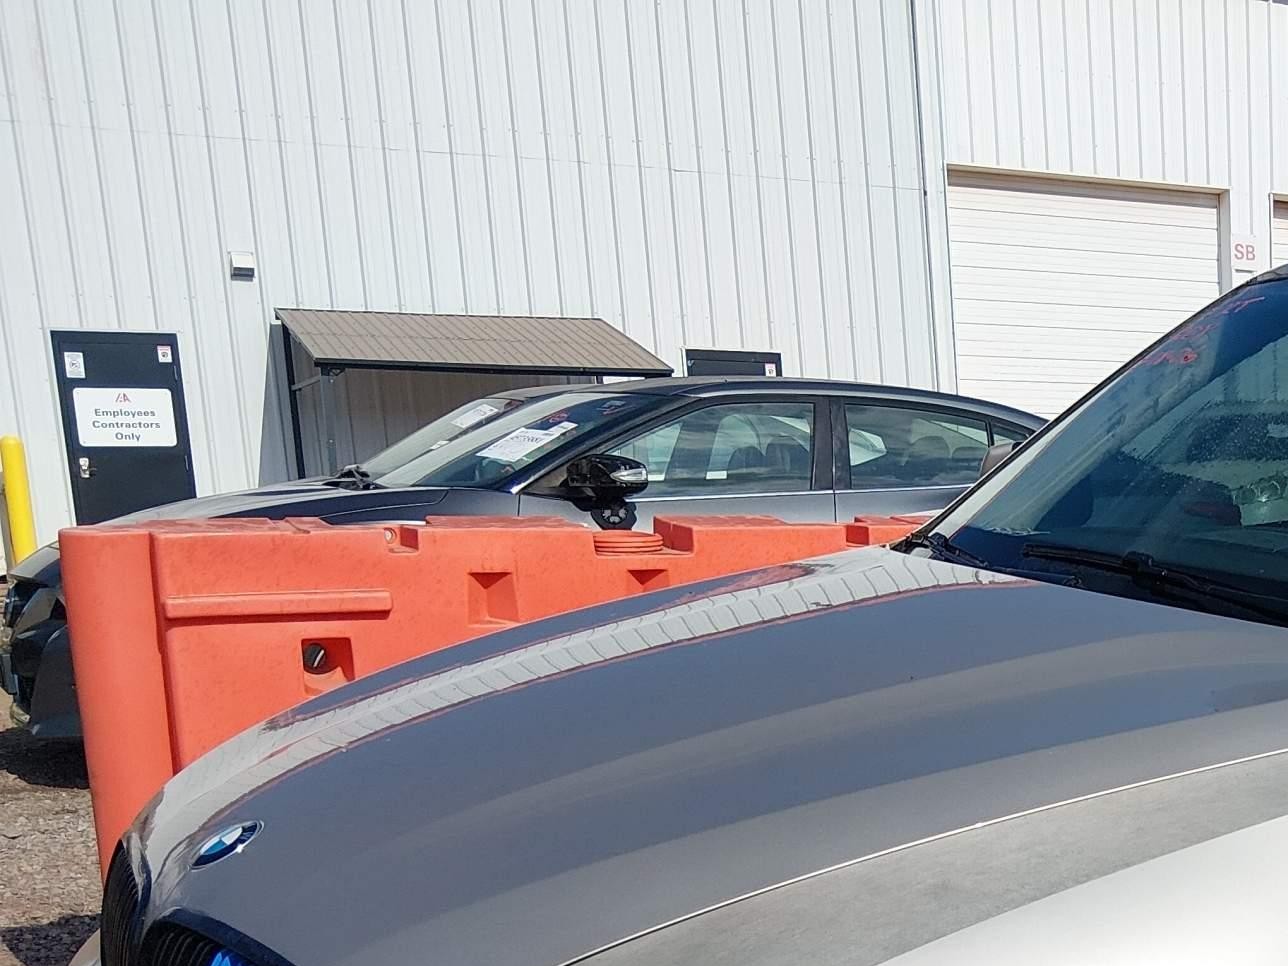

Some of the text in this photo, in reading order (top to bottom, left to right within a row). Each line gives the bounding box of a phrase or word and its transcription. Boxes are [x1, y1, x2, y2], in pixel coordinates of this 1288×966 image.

[1234, 243, 1256, 261] SB
[94, 408, 156, 418] Employees
[92, 420, 161, 429] Contractors
[115, 432, 141, 441] Only
